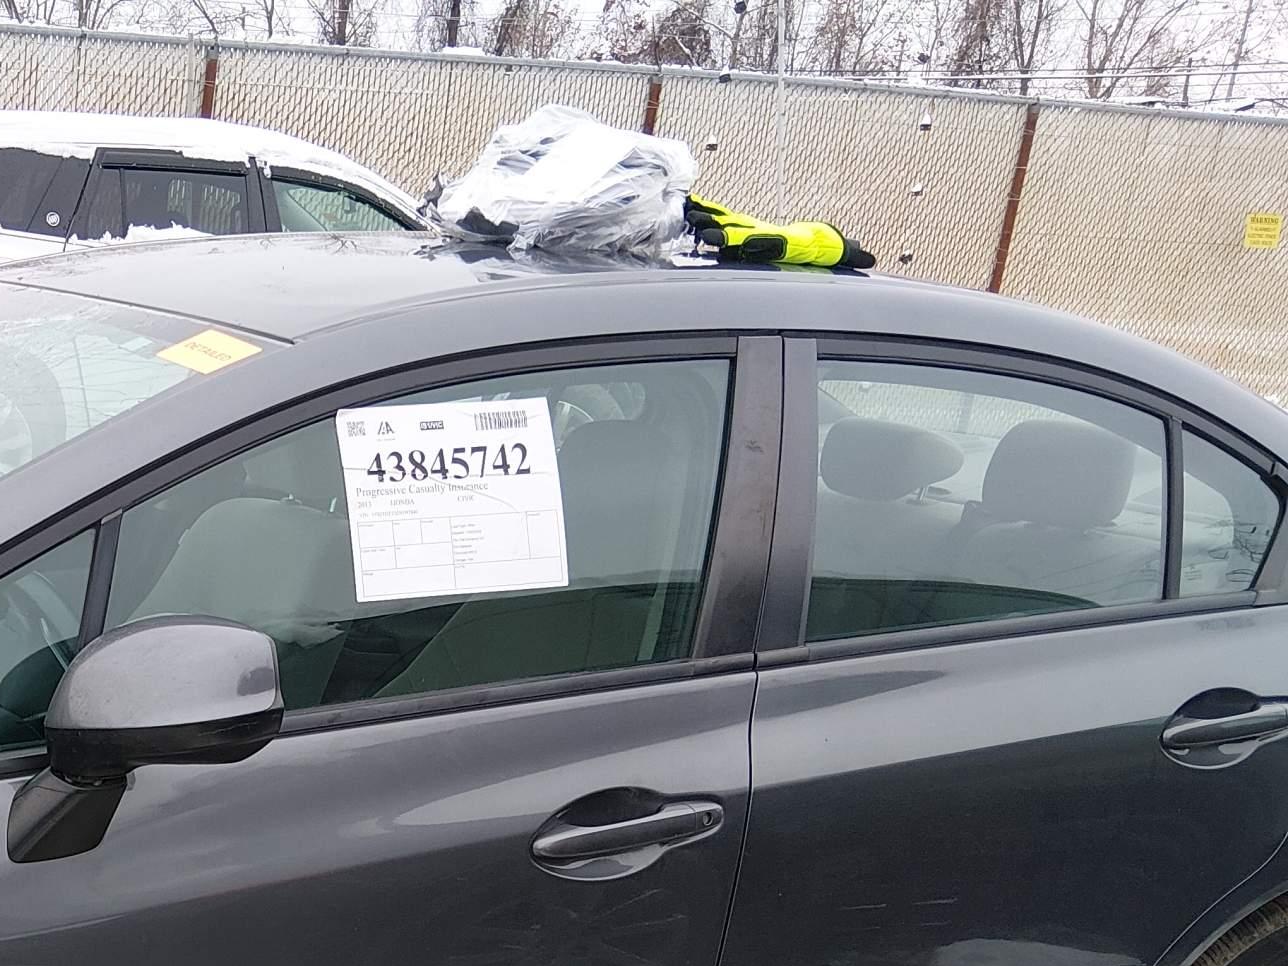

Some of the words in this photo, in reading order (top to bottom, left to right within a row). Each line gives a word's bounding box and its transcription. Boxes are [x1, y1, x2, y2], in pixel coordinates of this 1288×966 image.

[367, 442, 532, 483] 43845742
[355, 486, 407, 499] Progressive
[408, 483, 446, 495] Casualty
